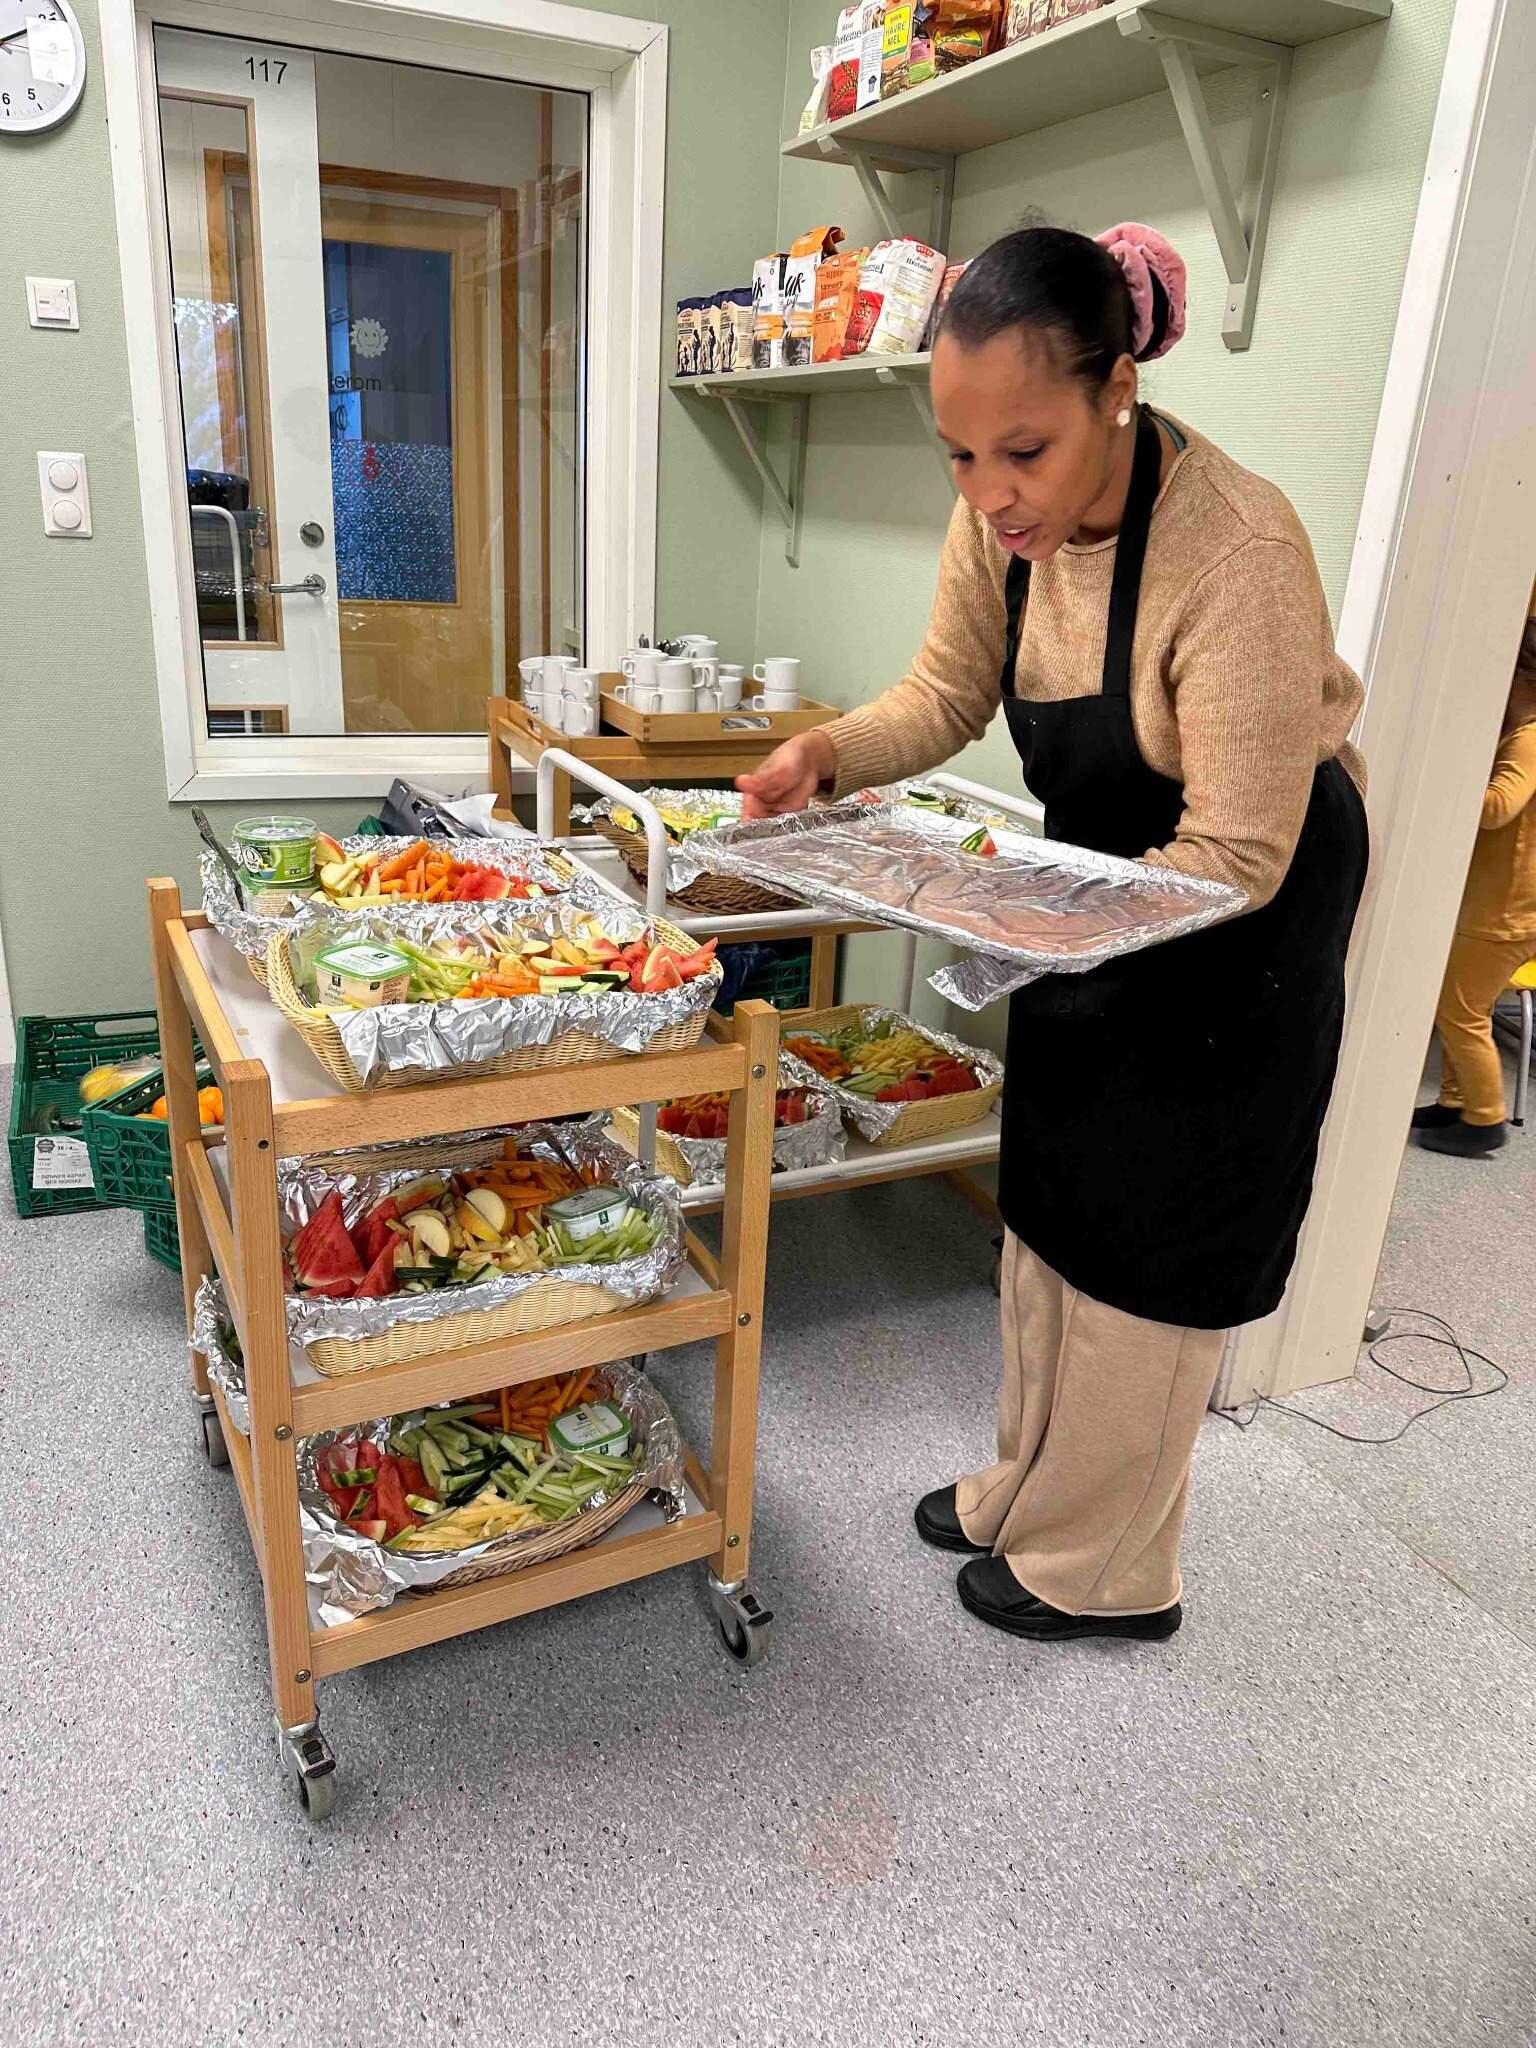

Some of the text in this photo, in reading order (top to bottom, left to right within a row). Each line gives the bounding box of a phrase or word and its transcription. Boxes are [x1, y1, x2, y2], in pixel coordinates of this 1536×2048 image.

[886, 22, 905, 34] HAVRE
[888, 35, 901, 45] MEL
[245, 56, 287, 84] 117
[2, 92, 11, 105] 6
[27, 87, 36, 100] 5
[332, 374, 382, 391] erom
